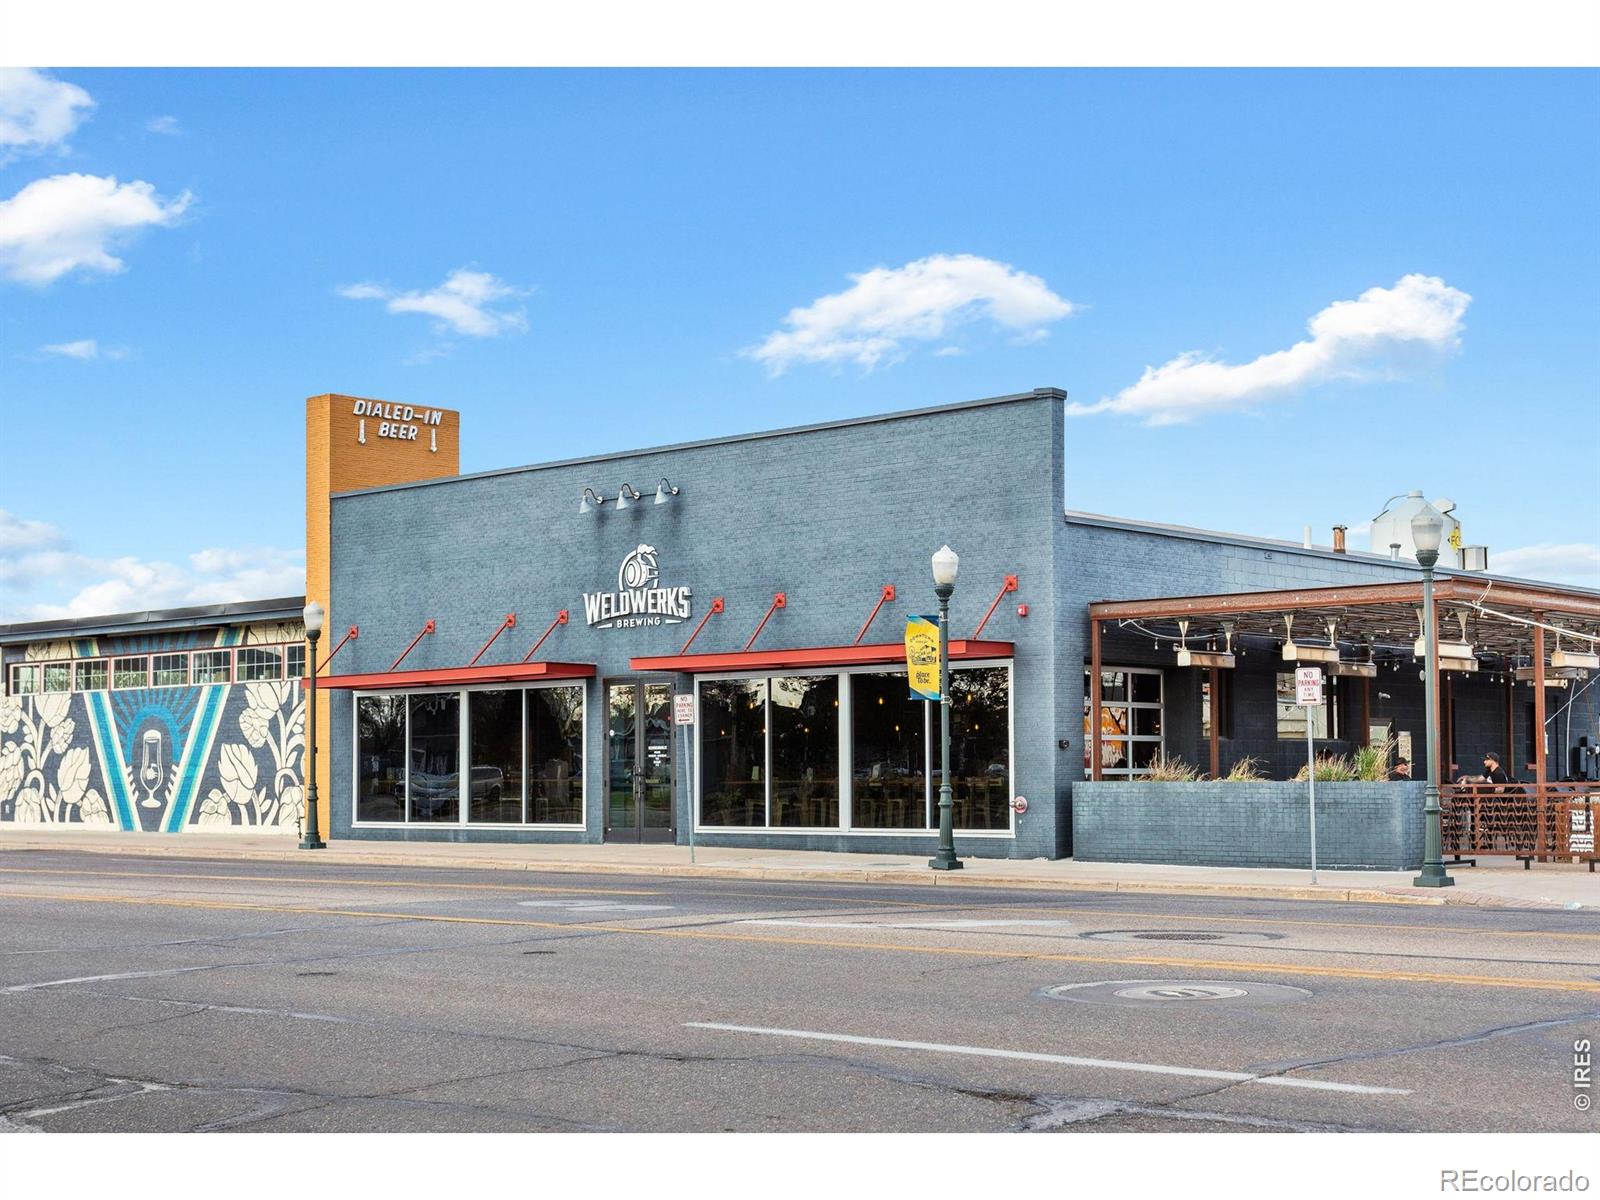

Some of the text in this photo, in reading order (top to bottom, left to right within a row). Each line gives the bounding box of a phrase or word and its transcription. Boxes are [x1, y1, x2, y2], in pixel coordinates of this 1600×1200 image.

[353, 400, 443, 425] DIALED-IN
[378, 422, 418, 441] BEER
[583, 587, 692, 625] WELDWERKS
[616, 617, 661, 628] BREWING
